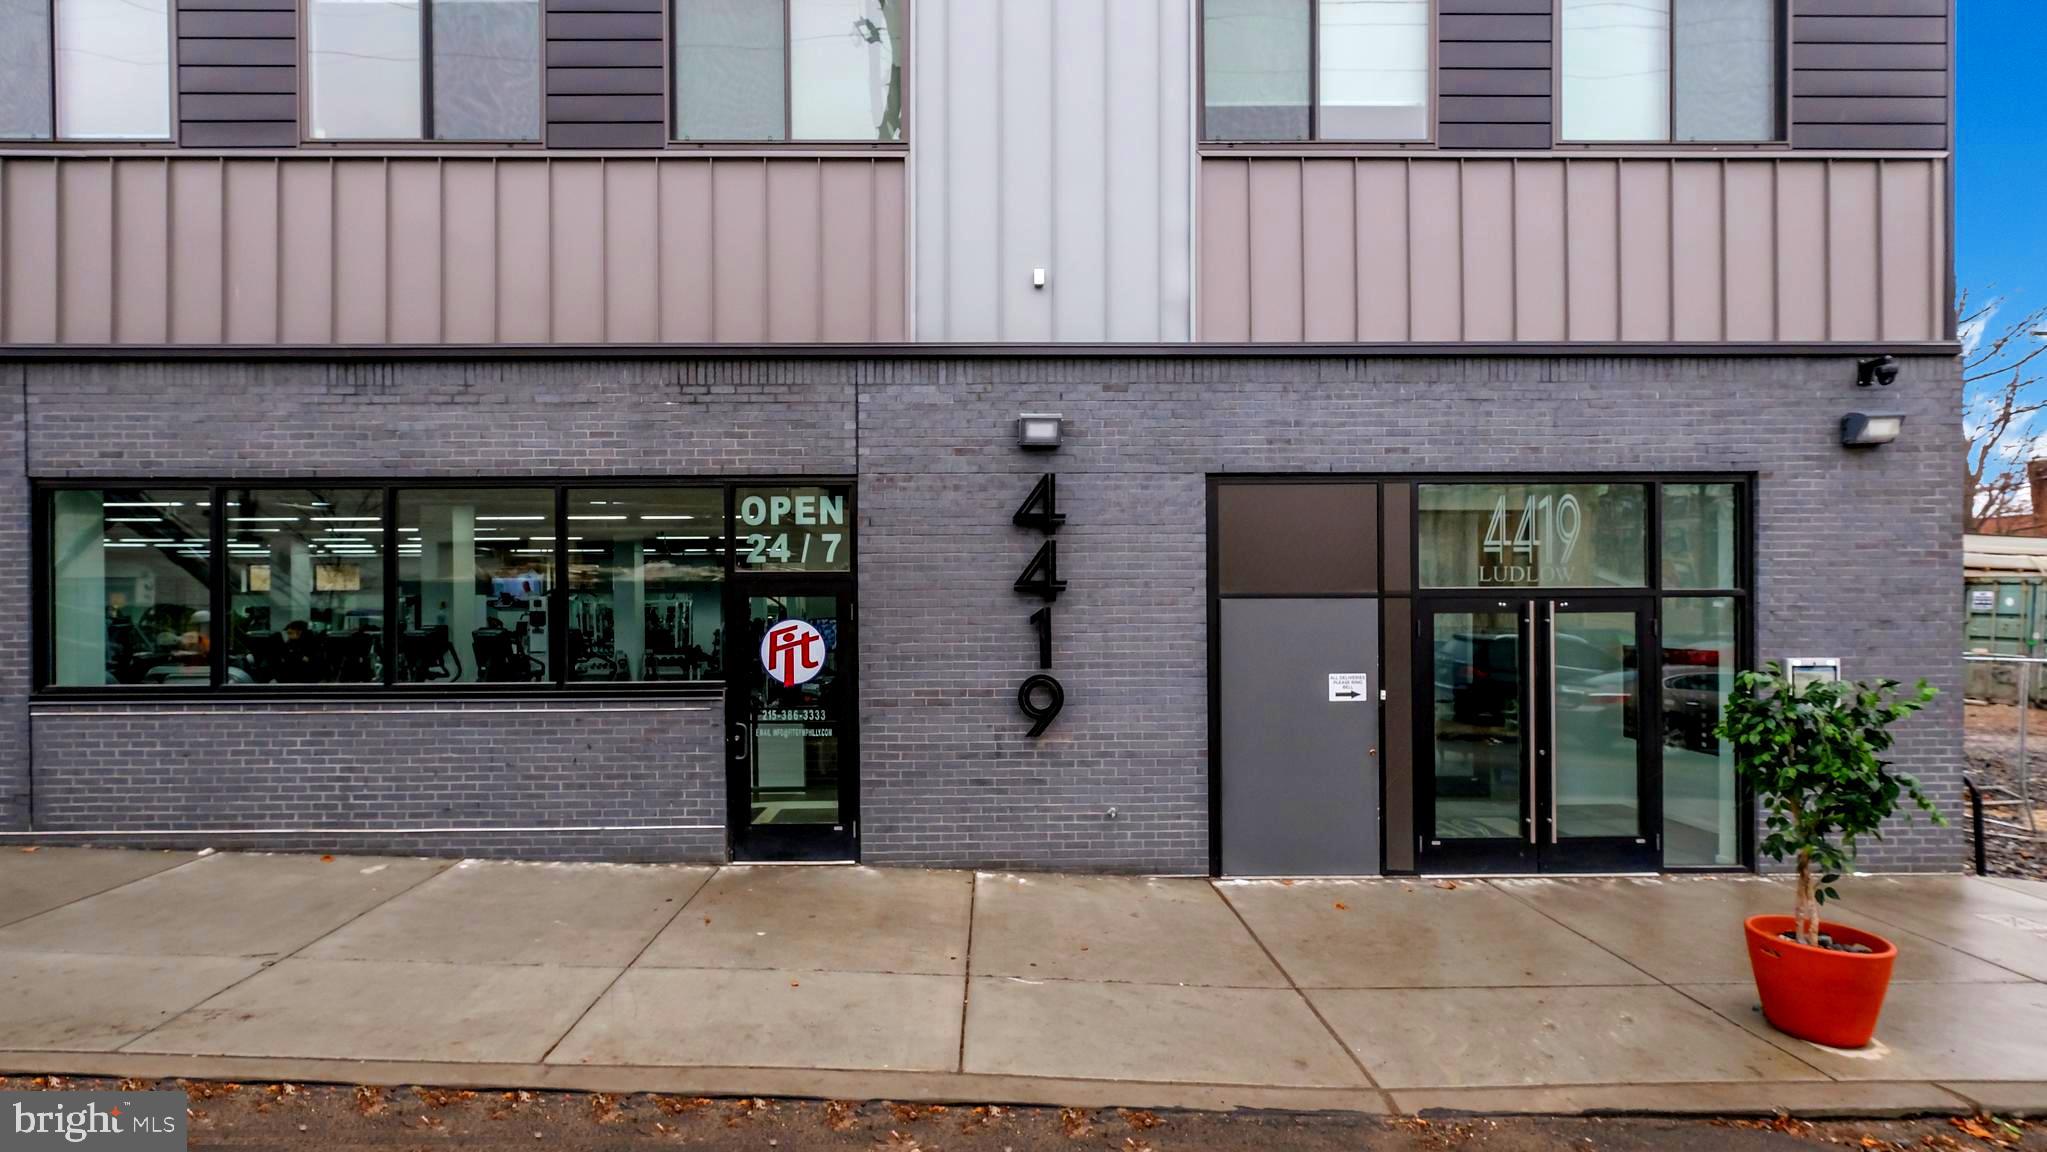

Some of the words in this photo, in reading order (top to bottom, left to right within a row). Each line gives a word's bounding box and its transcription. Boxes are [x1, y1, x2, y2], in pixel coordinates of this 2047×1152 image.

[741, 495, 844, 526] OPEN
[1483, 494, 1581, 564] 4419
[1479, 566, 1575, 582] LUDLOW
[769, 625, 820, 688] Fit
[762, 710, 826, 720] 215-386-3333
